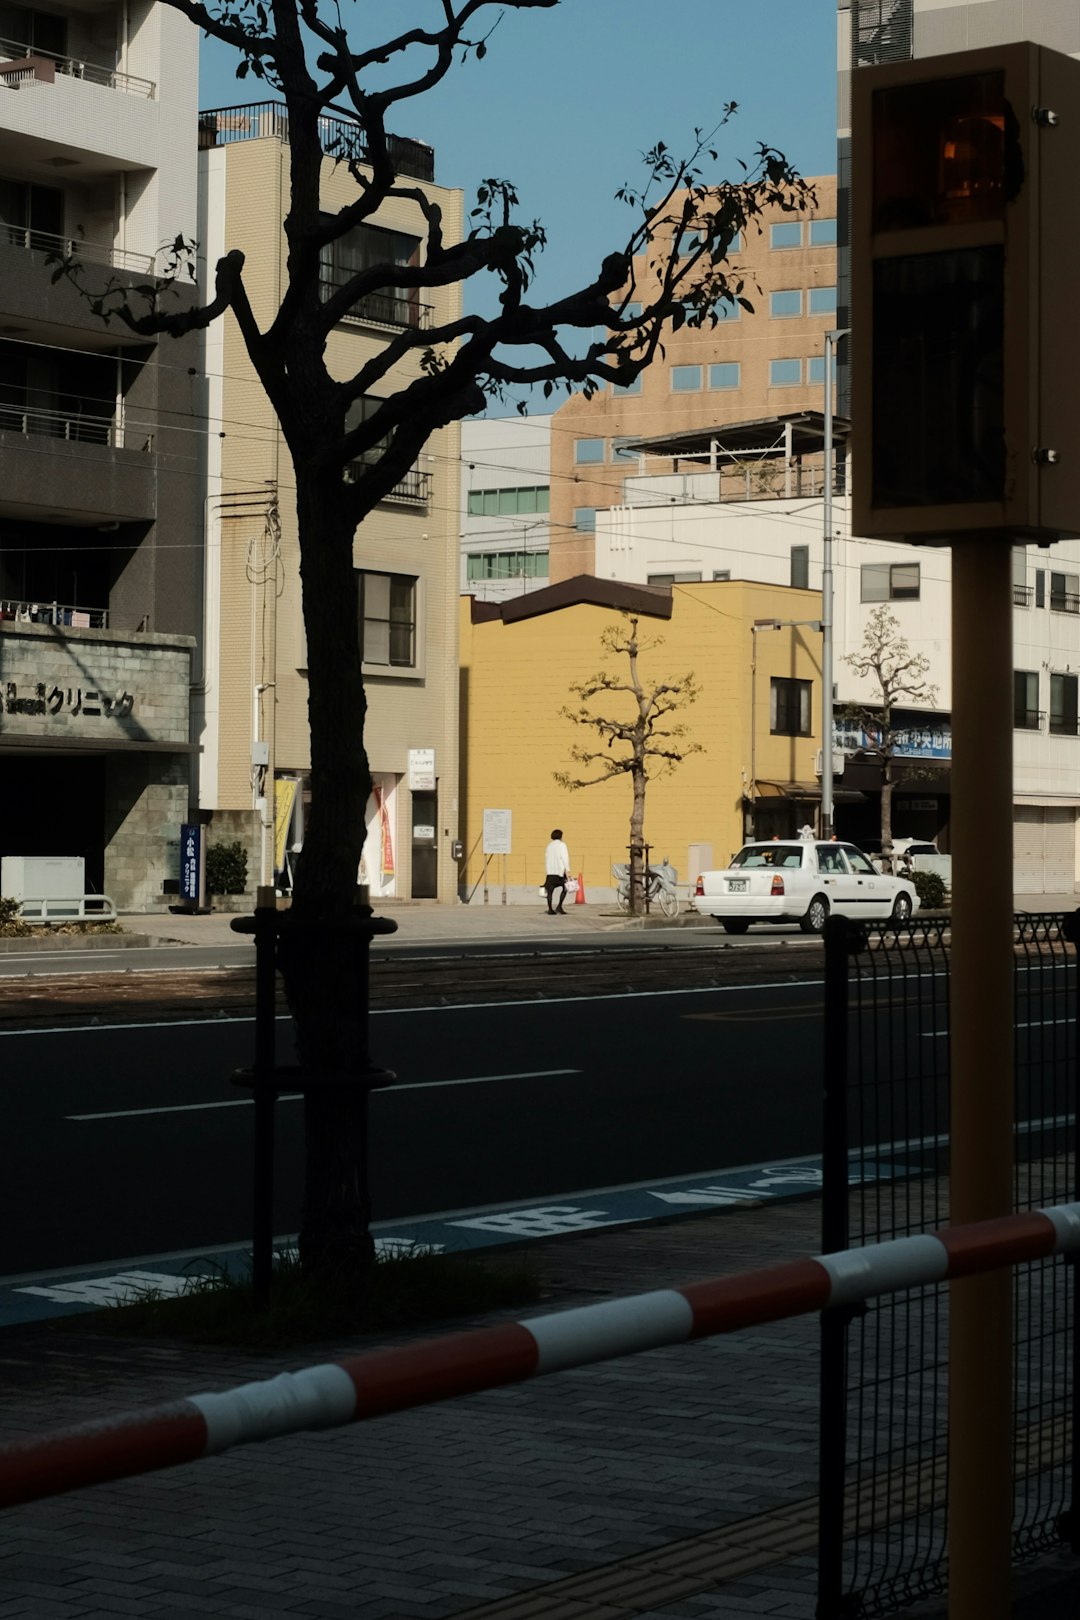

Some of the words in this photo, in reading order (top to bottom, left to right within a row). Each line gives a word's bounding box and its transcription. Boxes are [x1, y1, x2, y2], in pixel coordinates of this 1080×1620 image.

[47, 686, 135, 717] クリニック
[186, 837, 195, 857] 小松
